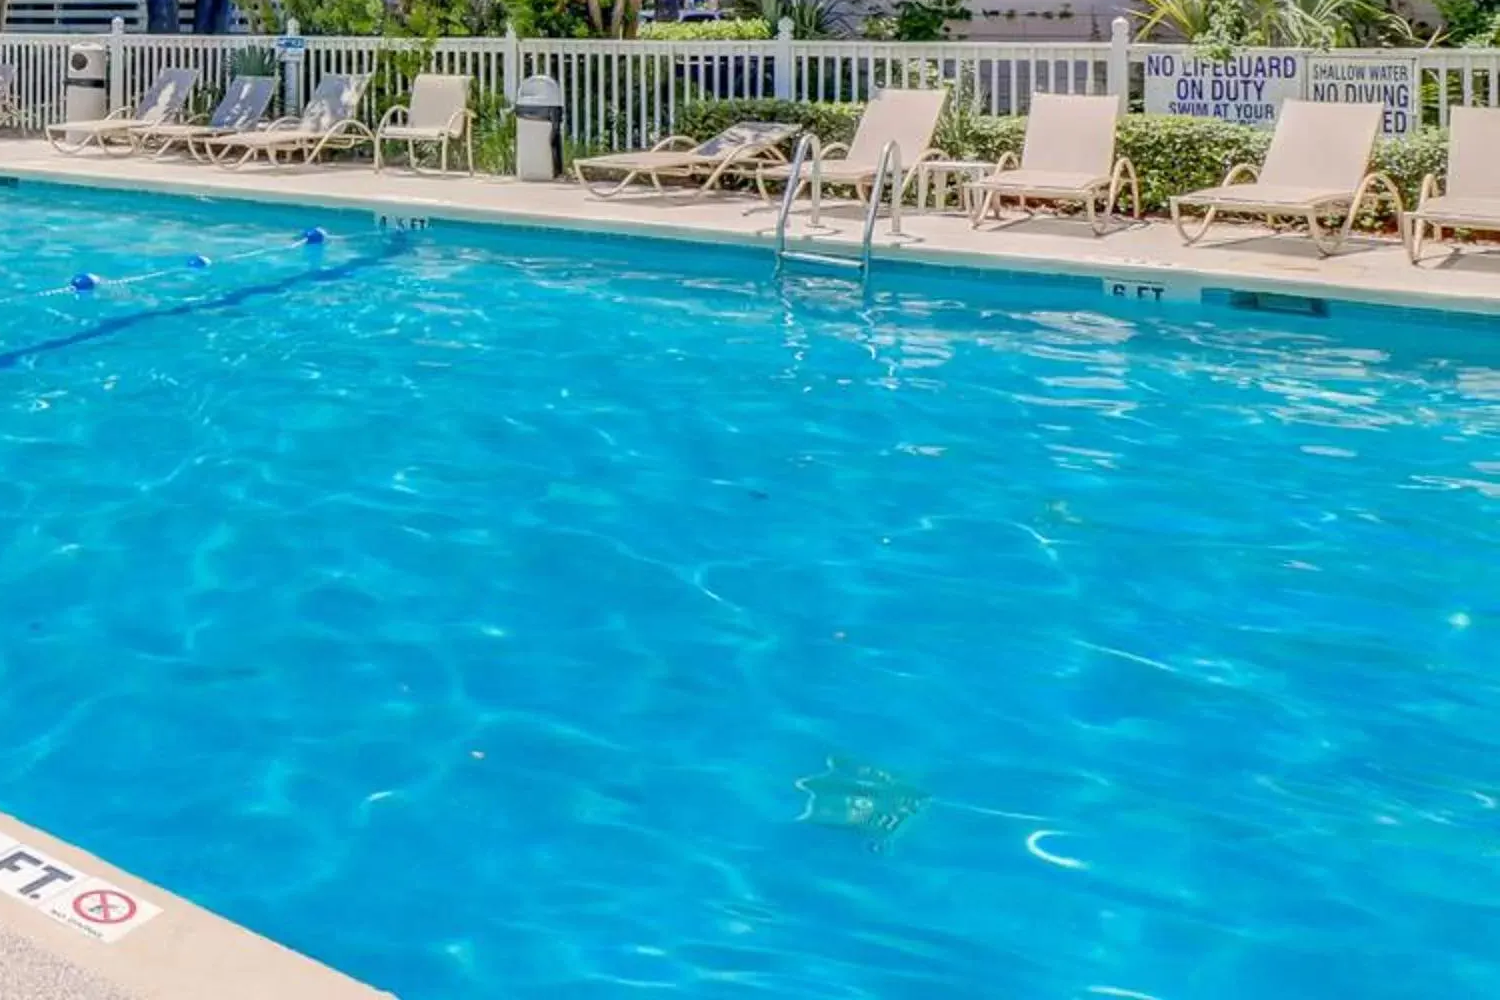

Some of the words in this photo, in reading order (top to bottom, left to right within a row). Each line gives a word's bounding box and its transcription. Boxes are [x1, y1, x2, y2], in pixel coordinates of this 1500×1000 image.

[1147, 55, 1175, 77] NO
[1182, 55, 1297, 79] LIFEGUARD
[1313, 63, 1365, 81] SHALLOW
[1368, 65, 1409, 82] WATER
[1176, 78, 1203, 100] ON
[1211, 79, 1265, 102] DUTY
[1313, 83, 1339, 102] NO
[1345, 83, 1409, 107] DIVING
[1168, 101, 1209, 116] SWIM
[1213, 102, 1229, 118] AT
[1235, 103, 1275, 120] YOUR
